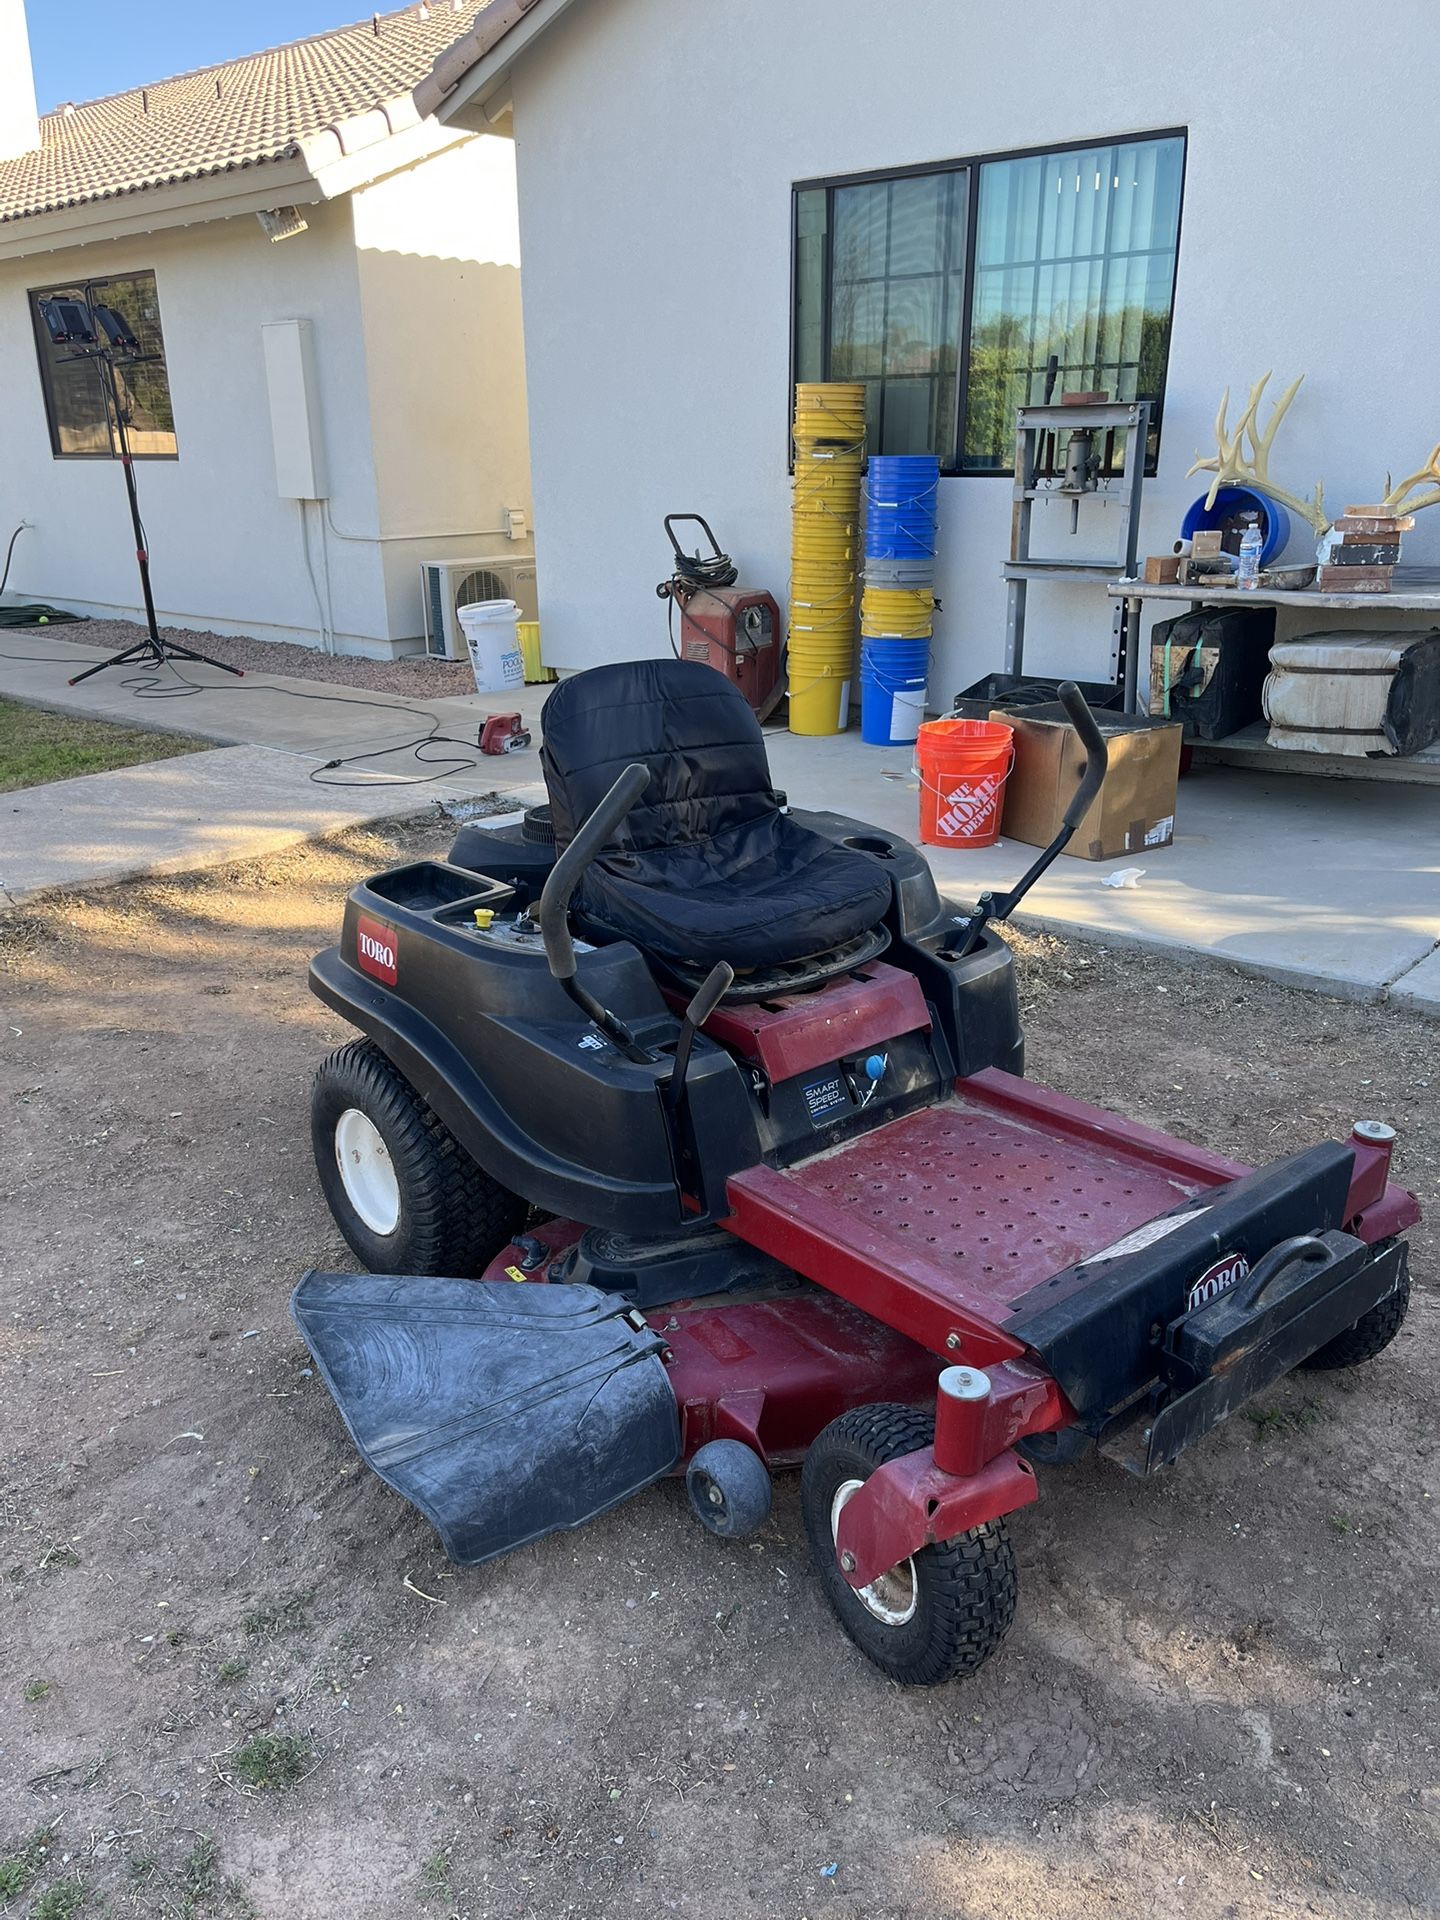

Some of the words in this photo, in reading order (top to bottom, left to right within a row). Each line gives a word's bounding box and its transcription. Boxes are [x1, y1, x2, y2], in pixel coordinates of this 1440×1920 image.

[938, 774, 998, 836] HOME
[944, 782, 974, 807] THE
[961, 796, 997, 837] DEPOT
[805, 1079, 839, 1100] SMART
[808, 1090, 840, 1109] SPEED
